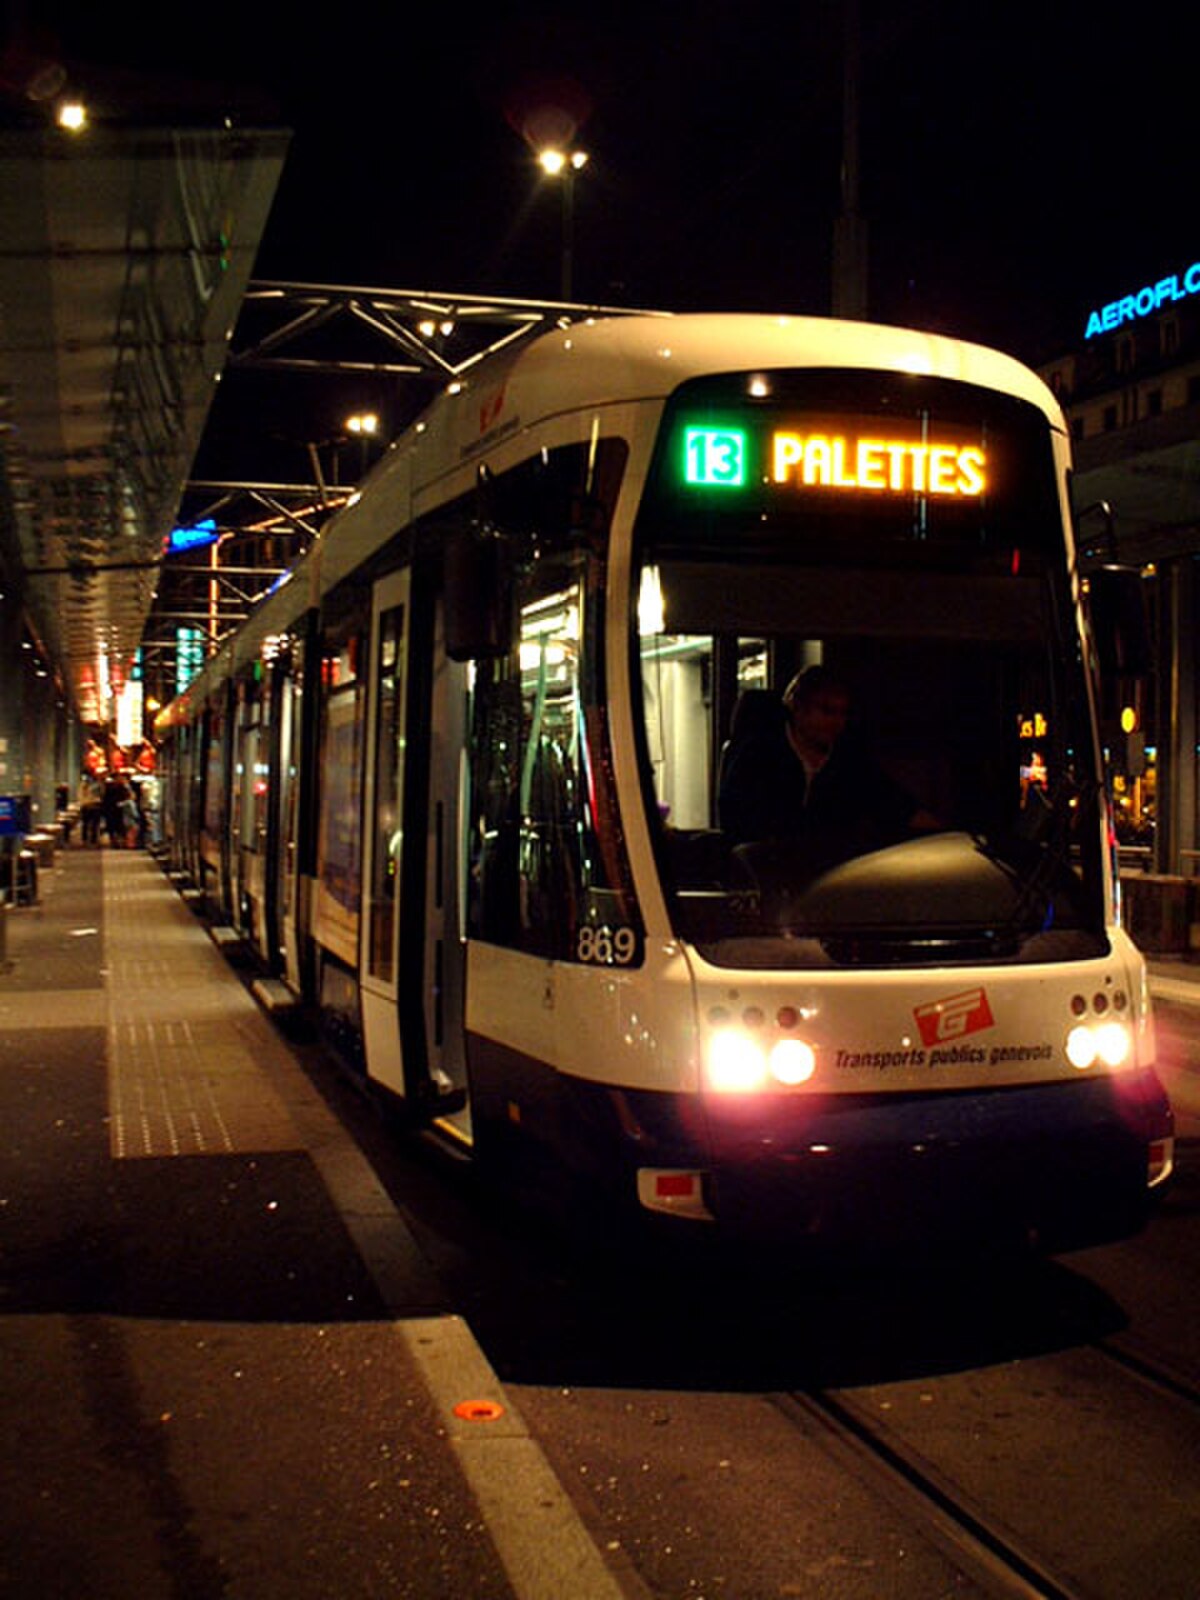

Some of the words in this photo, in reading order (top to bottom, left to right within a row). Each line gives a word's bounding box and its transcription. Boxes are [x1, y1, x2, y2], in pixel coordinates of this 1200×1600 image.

[688, 432, 741, 484] 13
[772, 431, 986, 496] PALETTES
[578, 926, 635, 963] 869
[836, 1046, 924, 1070] Transports
[929, 1044, 985, 1066] publics
[991, 1045, 1053, 1064] genevois
